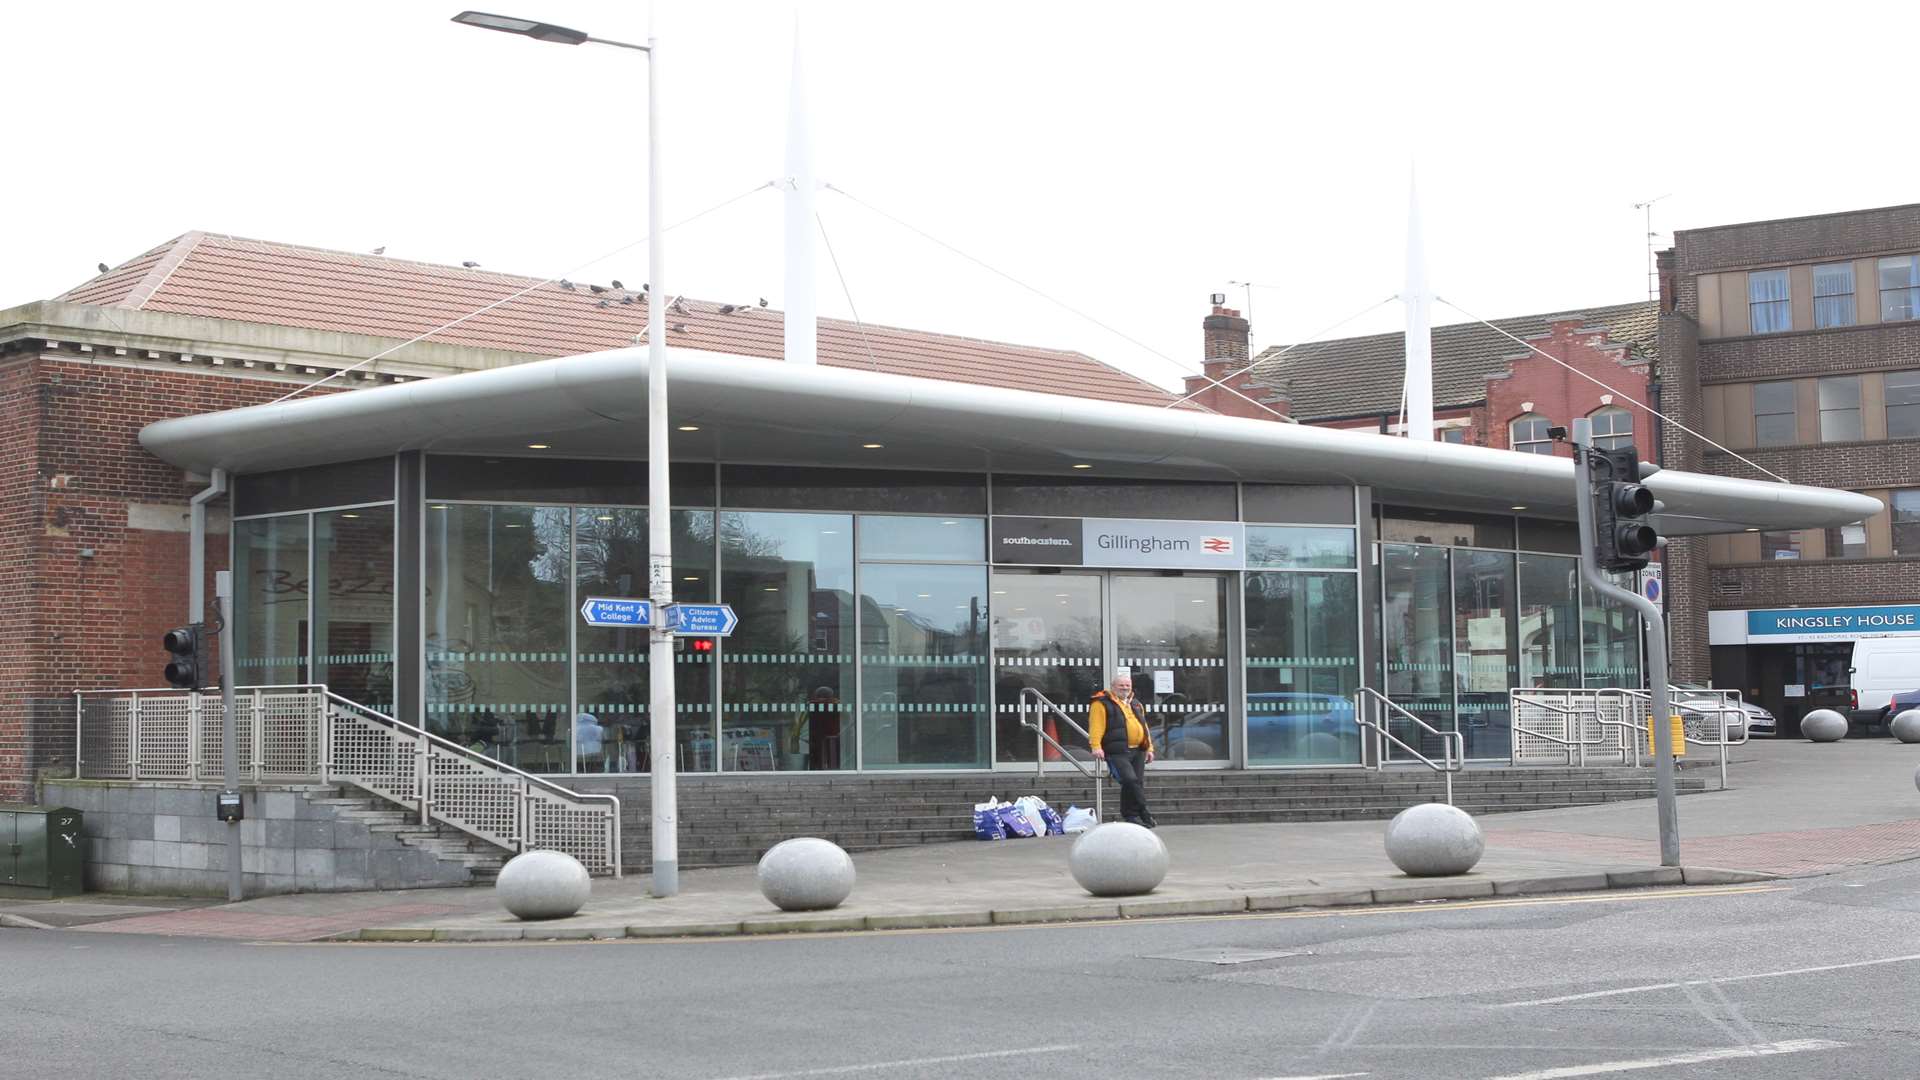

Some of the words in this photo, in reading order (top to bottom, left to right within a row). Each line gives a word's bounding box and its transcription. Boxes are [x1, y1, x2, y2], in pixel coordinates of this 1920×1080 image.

[1097, 534, 1191, 553] Gillingham
[598, 603, 613, 611] Mid
[615, 604, 634, 612] Kent
[688, 608, 719, 616] Citizens
[600, 612, 633, 622] College
[1776, 616, 1853, 628] KINGSLEY
[1857, 614, 1915, 626] HOUSE
[690, 623, 718, 631] Bureau
